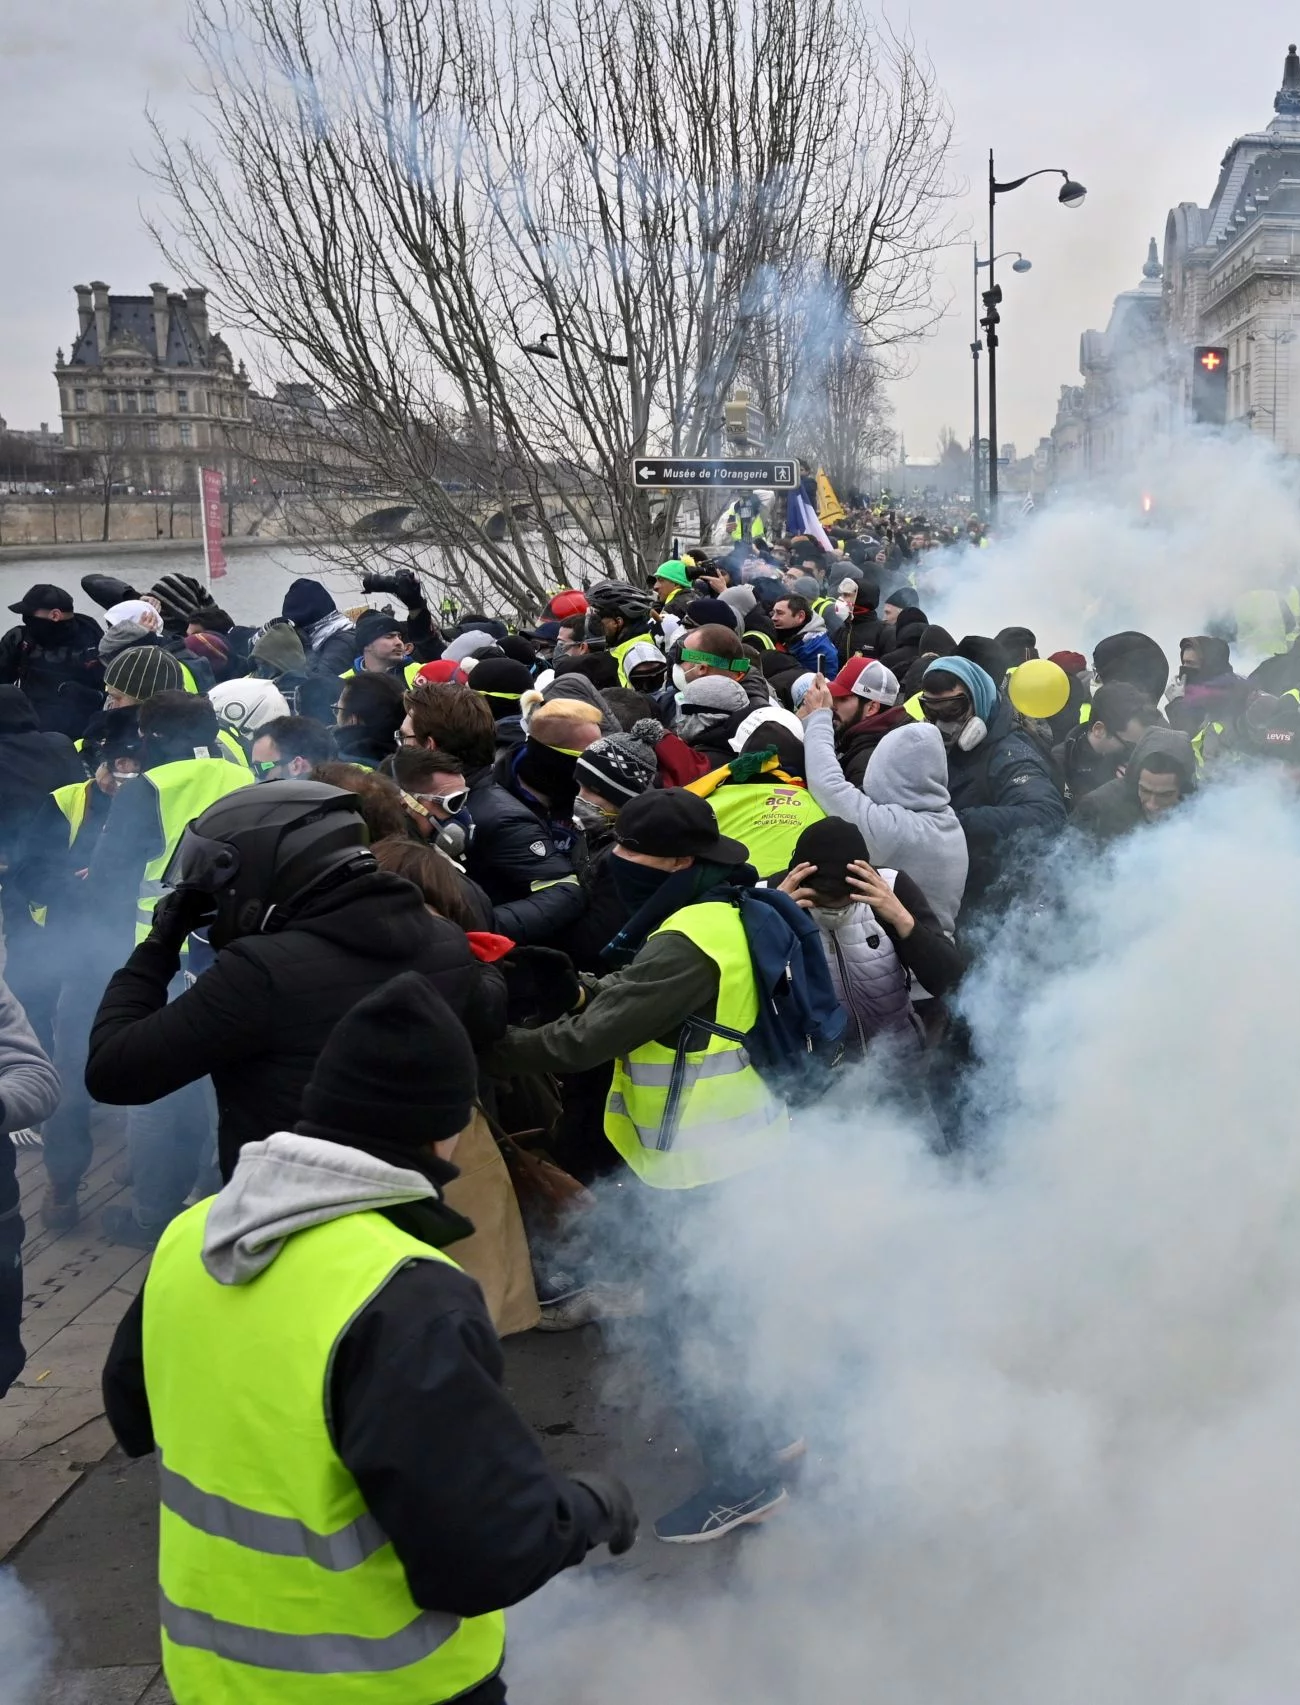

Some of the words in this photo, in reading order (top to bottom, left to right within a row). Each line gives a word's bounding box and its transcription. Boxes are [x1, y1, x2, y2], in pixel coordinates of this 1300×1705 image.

[663, 468, 696, 478] Musée
[699, 468, 711, 478] de
[714, 468, 768, 481] l'Orangerie
[766, 796, 801, 806] acto
